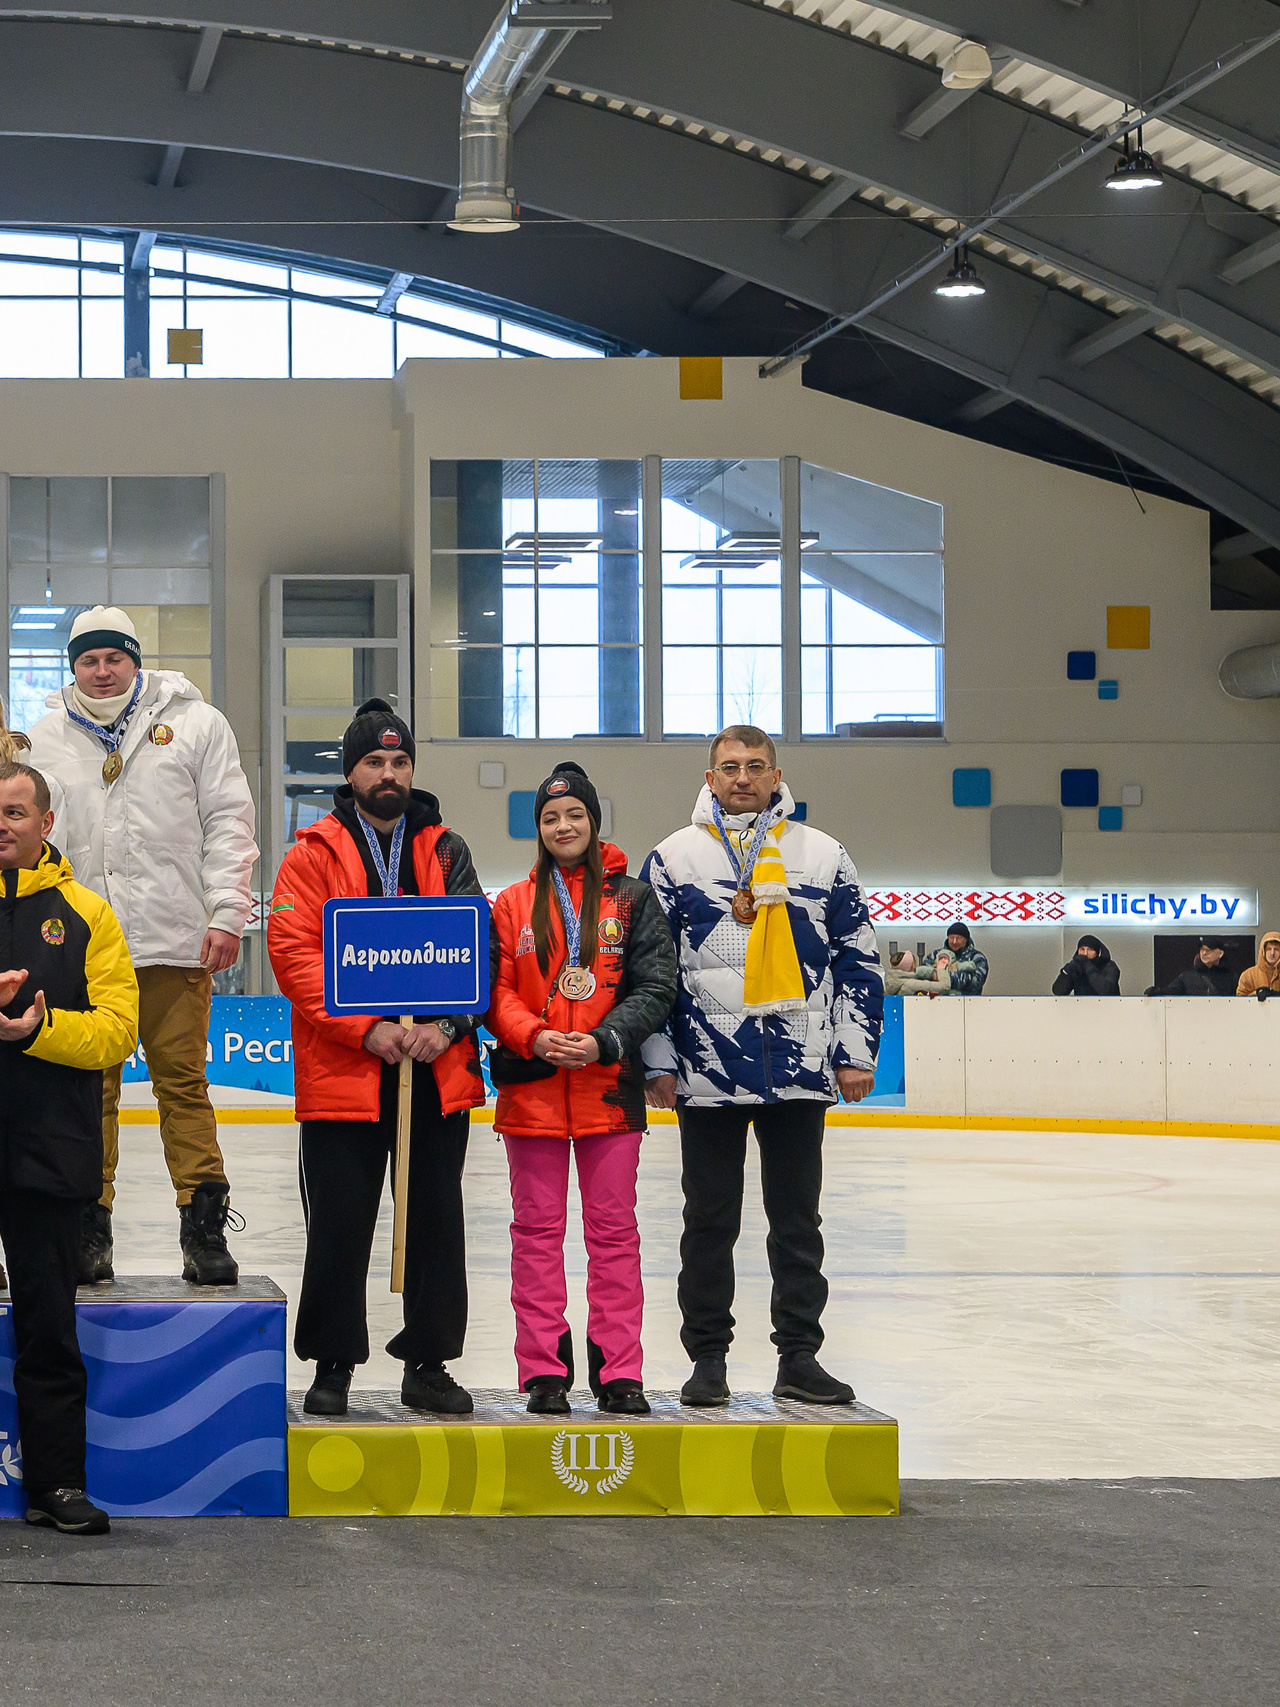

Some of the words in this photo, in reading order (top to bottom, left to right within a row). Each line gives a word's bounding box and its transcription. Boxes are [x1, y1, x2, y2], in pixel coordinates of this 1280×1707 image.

[1084, 893, 1240, 920] silichy.by
[341, 940, 471, 972] Агрохолдинг
[564, 1433, 621, 1470] III
